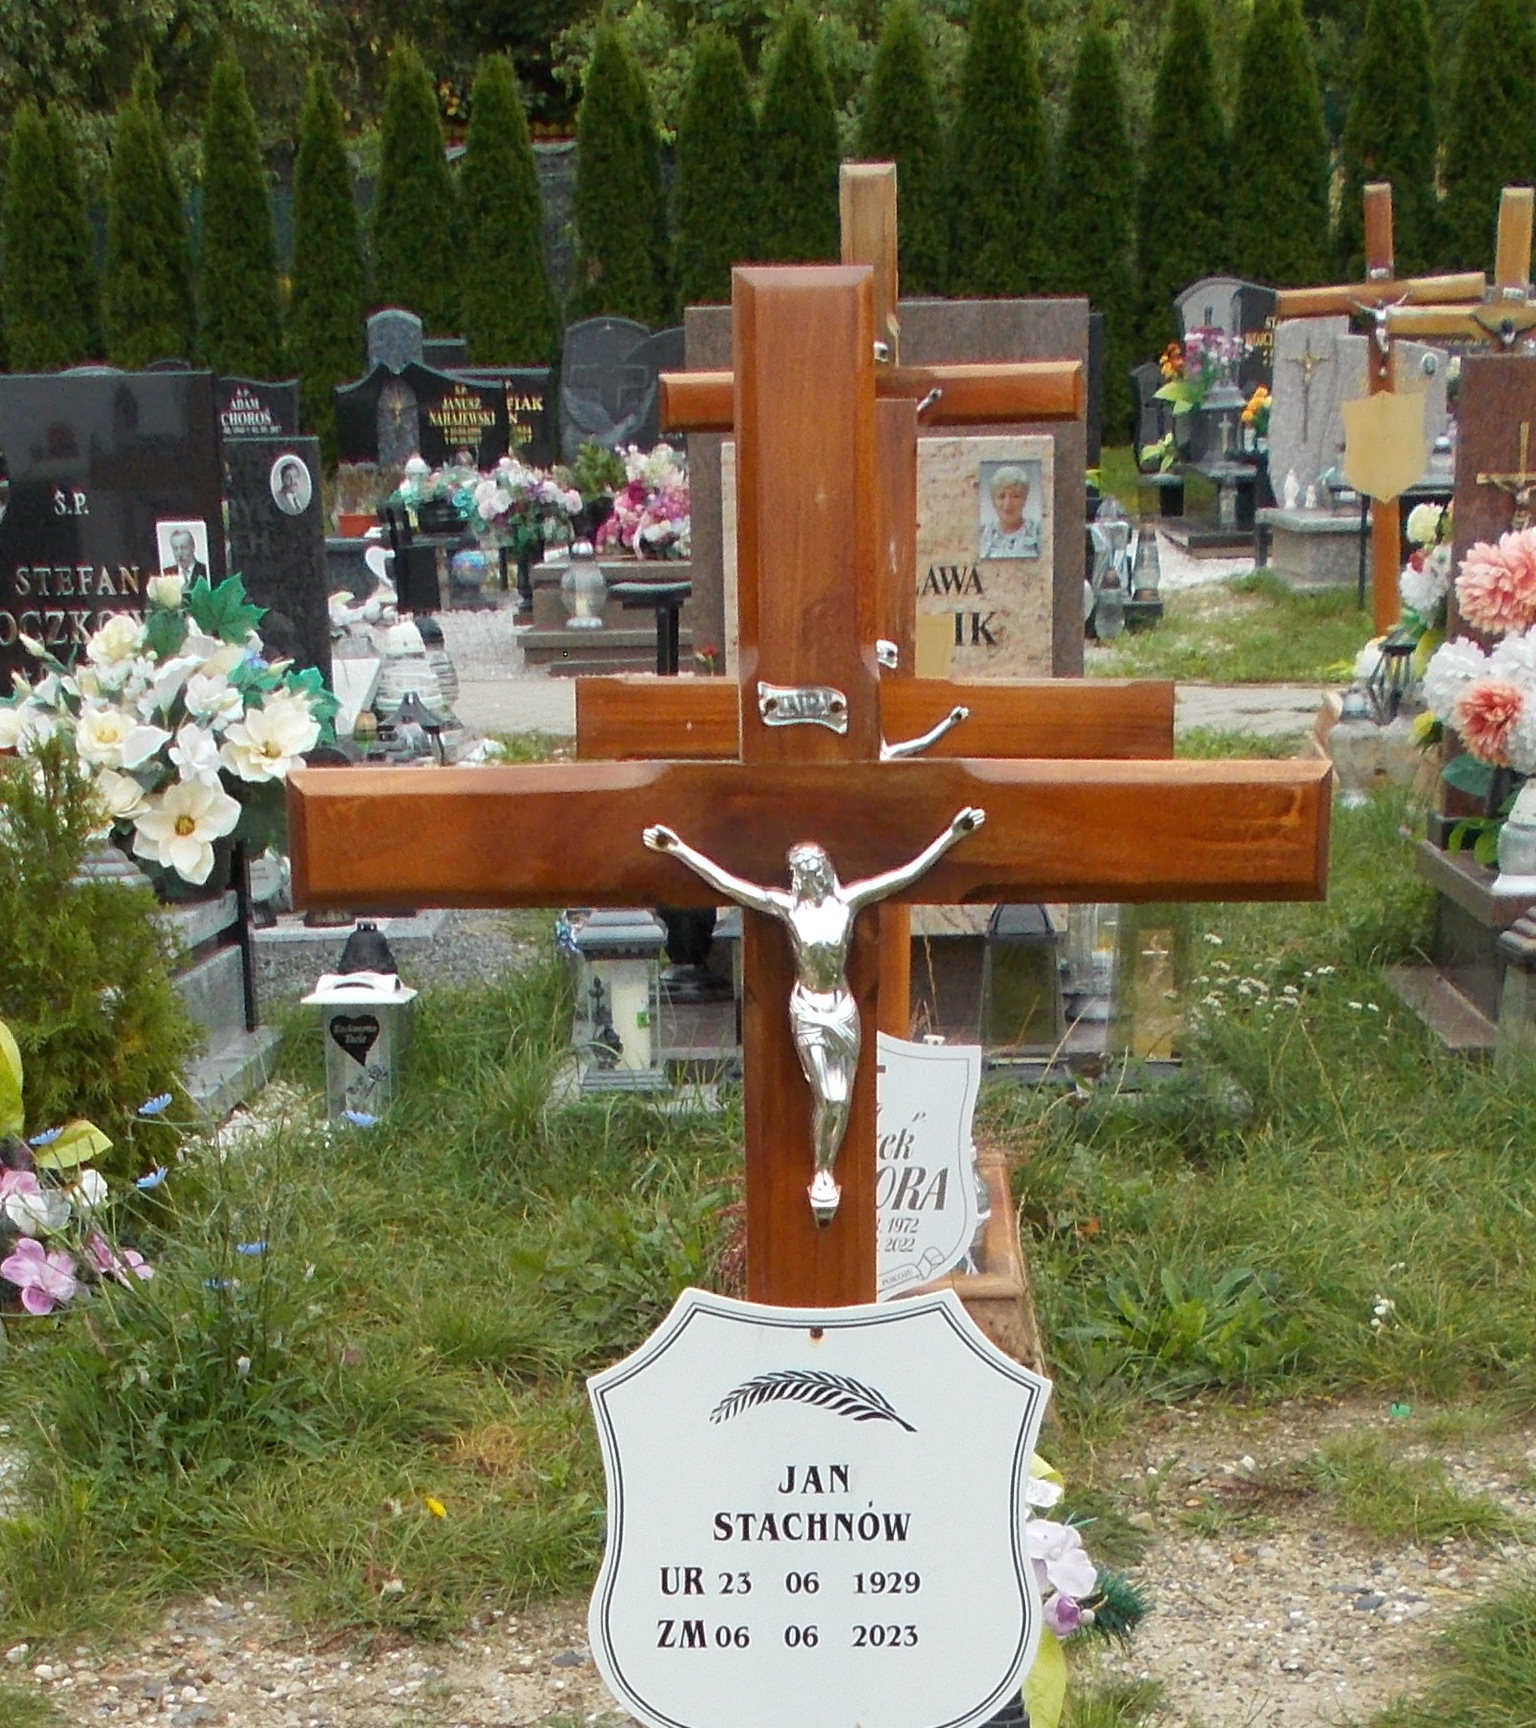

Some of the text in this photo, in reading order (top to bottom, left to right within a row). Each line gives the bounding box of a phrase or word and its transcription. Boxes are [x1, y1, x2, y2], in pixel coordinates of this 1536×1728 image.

[231, 398, 260, 410] ADAM
[15, 566, 141, 597] STEFAN
[877, 1166, 949, 1211] ORA
[778, 1464, 850, 1494] JAN
[713, 1501, 912, 1542] STACHNÓW
[661, 1567, 921, 1595] UR 23 06 1929
[657, 1620, 919, 1649] ZM 06 06 2023
